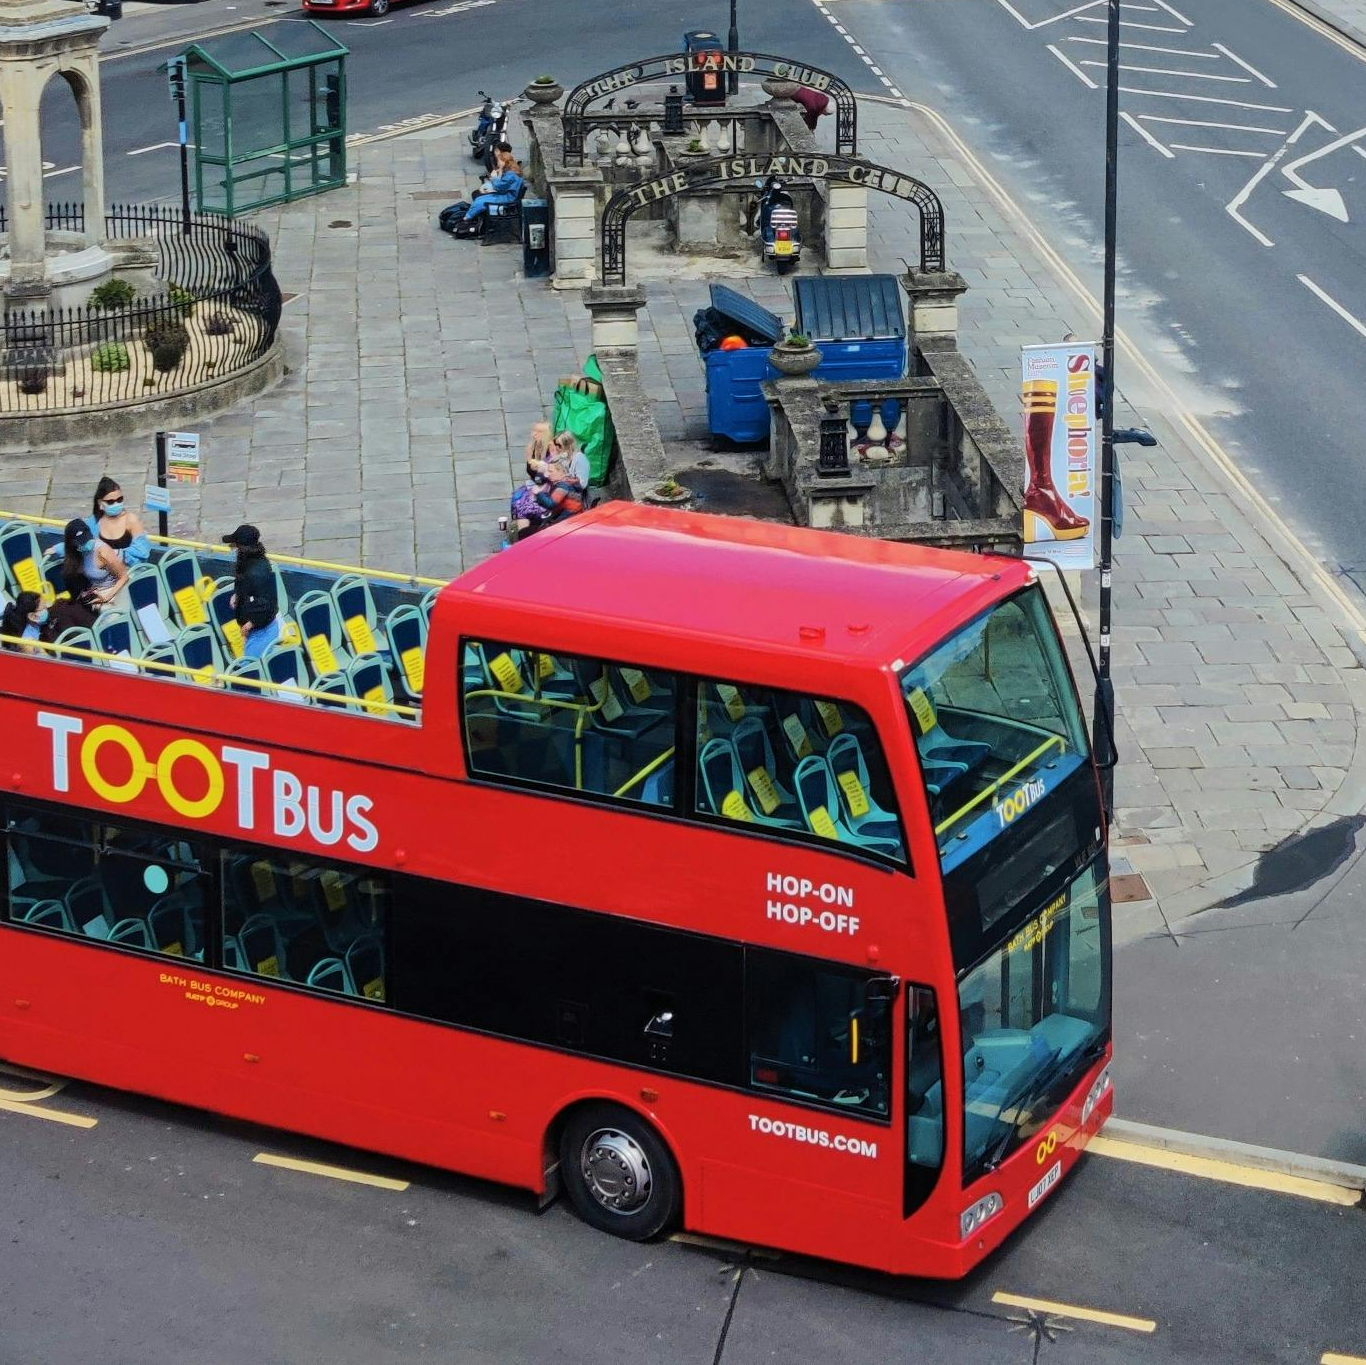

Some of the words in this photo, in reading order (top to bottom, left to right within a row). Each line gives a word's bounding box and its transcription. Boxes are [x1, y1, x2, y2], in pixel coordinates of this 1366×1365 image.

[665, 55, 756, 75] ISLAND
[630, 172, 689, 205] THE
[719, 157, 829, 180] ISLAND
[767, 872, 853, 907] HOP-ON
[767, 900, 859, 935] HOP-OFF
[159, 974, 187, 987] BATH
[190, 980, 212, 992] BUS
[215, 986, 266, 1004] COMPANY
[215, 999, 239, 1009] GROUP
[748, 1114, 877, 1158] TOOTBUS.COM
[1030, 1178, 1047, 1203] LJ07
